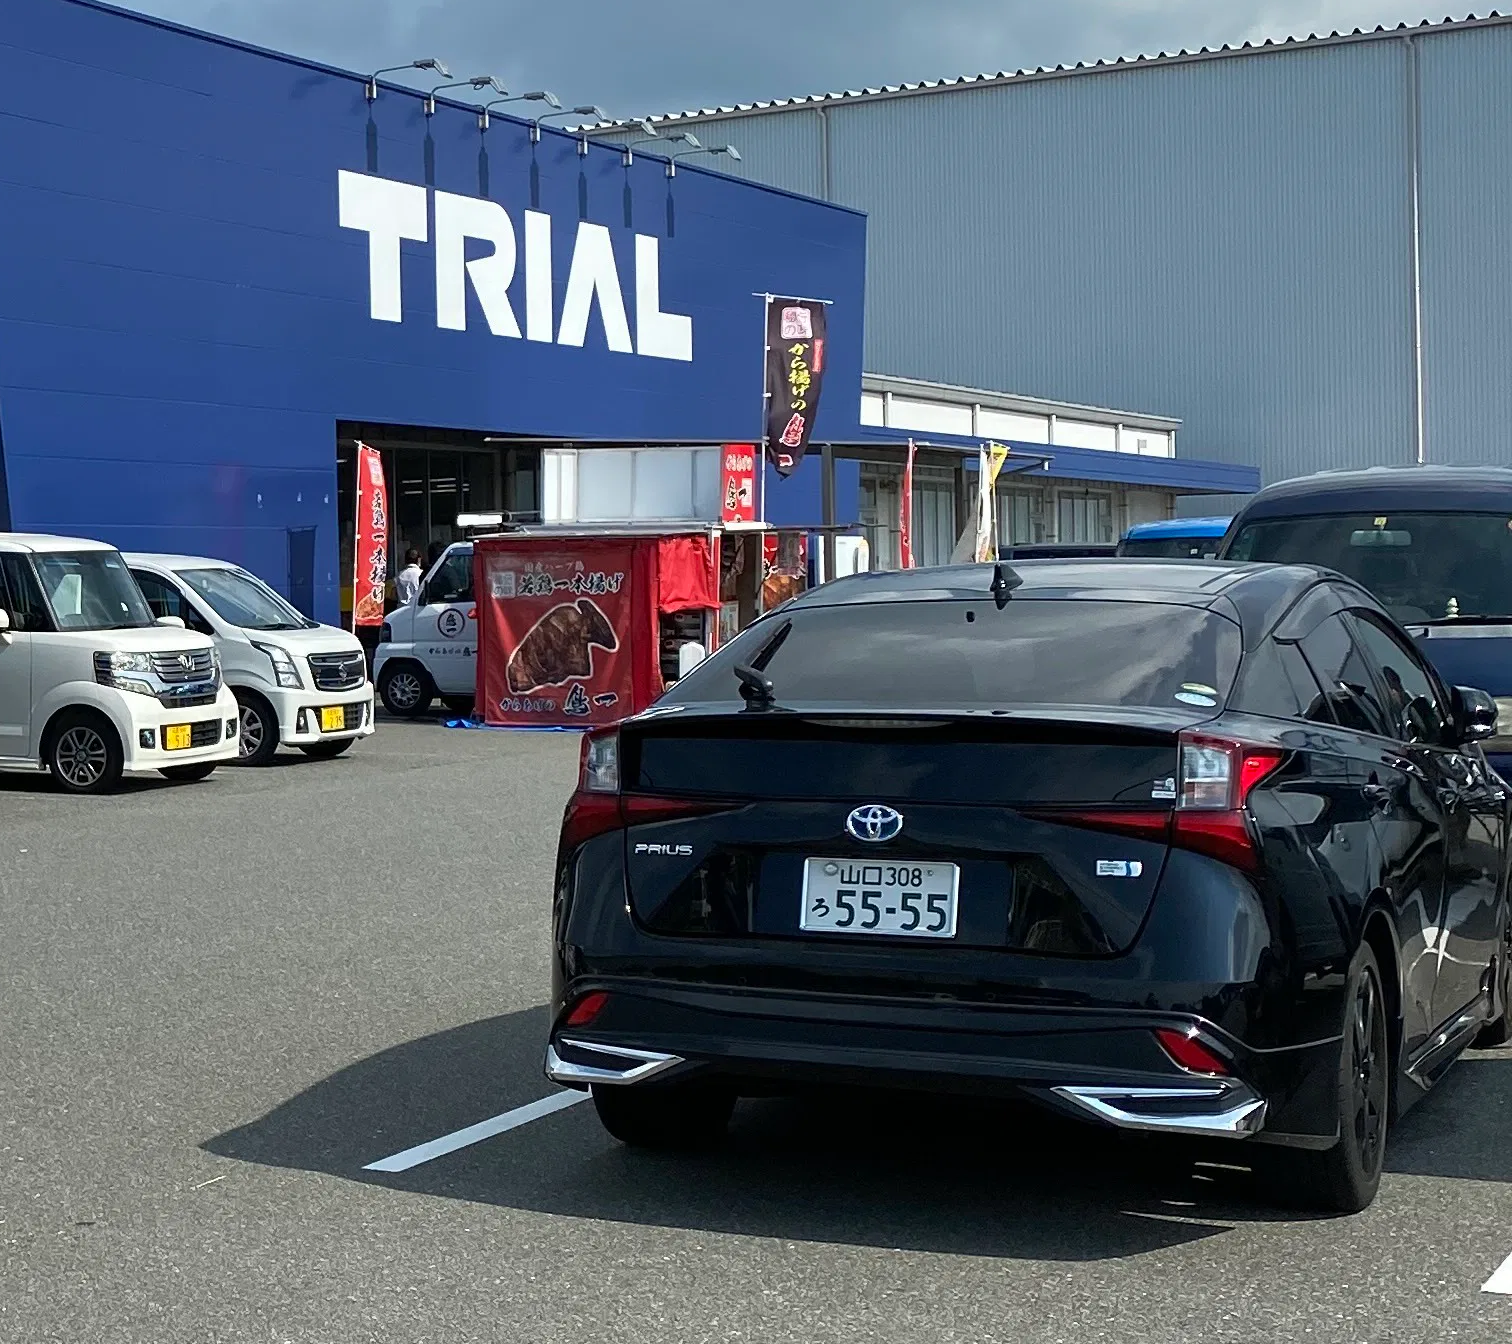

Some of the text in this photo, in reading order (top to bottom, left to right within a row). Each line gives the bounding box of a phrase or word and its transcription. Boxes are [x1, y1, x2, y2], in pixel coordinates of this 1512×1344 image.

[338, 169, 693, 362] TRIAL
[634, 843, 693, 856] PRIUS
[811, 889, 948, 932] ろ 55-55
